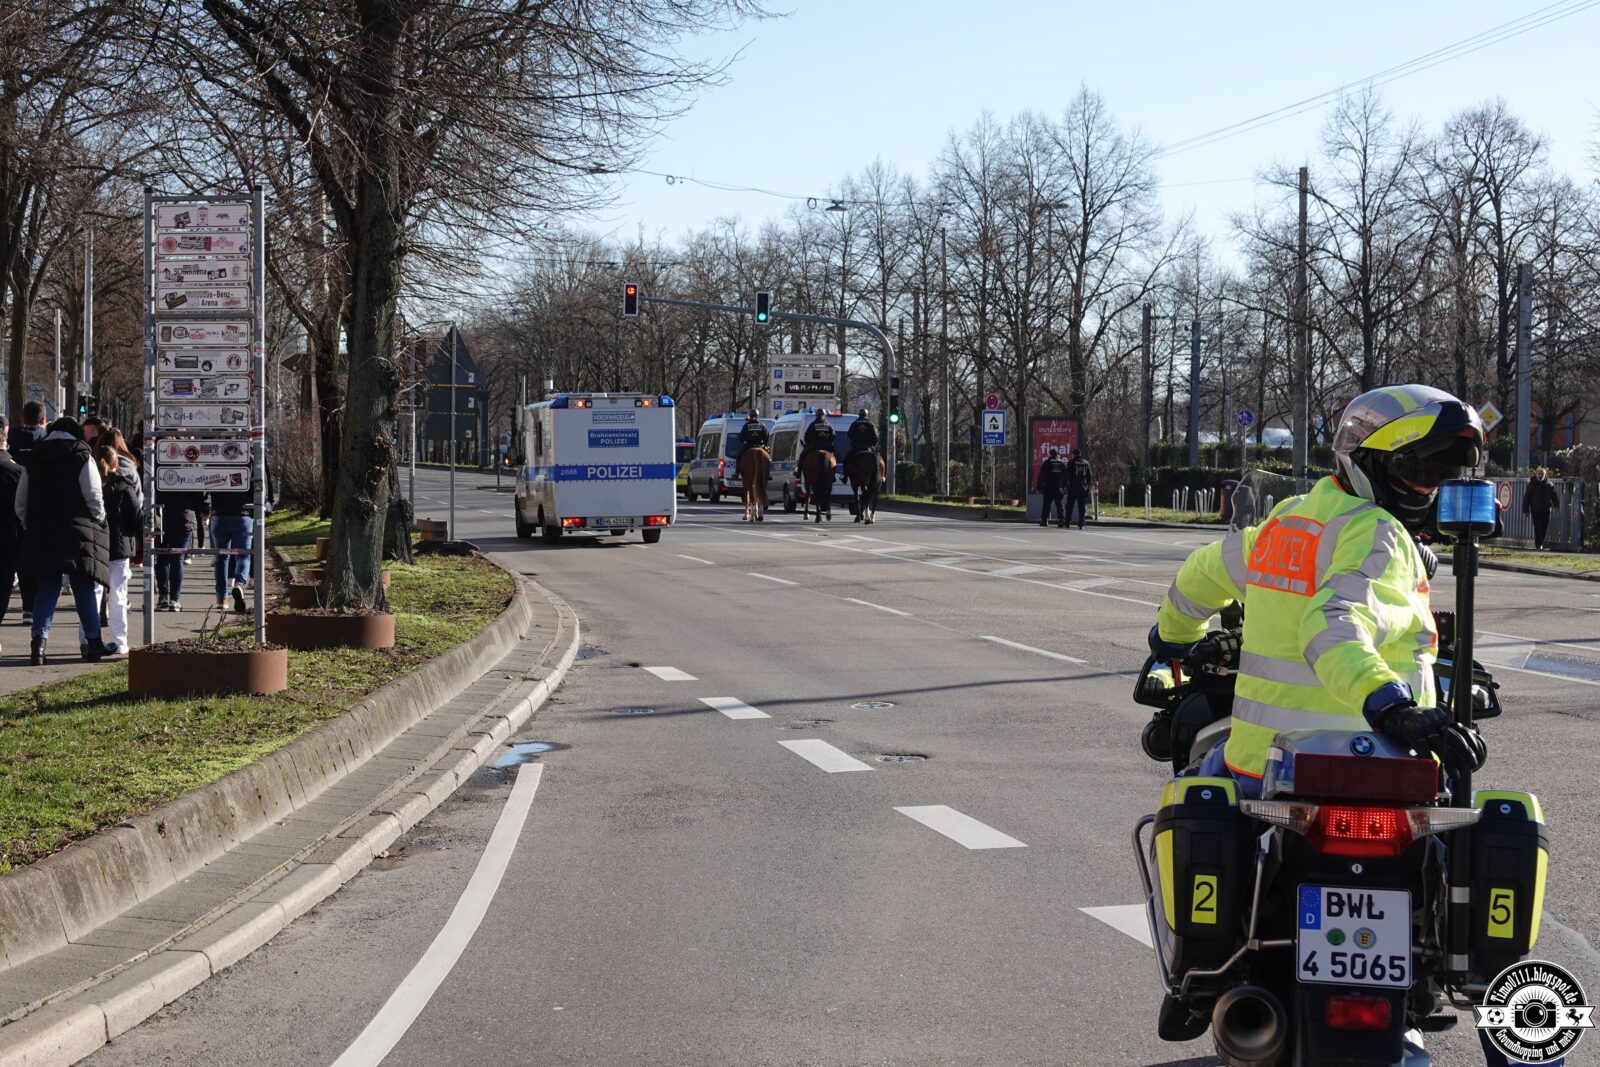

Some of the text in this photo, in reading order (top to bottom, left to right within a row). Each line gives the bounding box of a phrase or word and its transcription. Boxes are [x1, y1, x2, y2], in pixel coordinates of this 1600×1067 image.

[1040, 442, 1071, 455] final
[587, 466, 643, 479] POLIZEI
[1194, 881, 1215, 912] 2
[1326, 891, 1385, 920] BWL
[1490, 893, 1511, 925] 5
[1305, 912, 1316, 924] D
[1302, 950, 1406, 982] 4 5065
